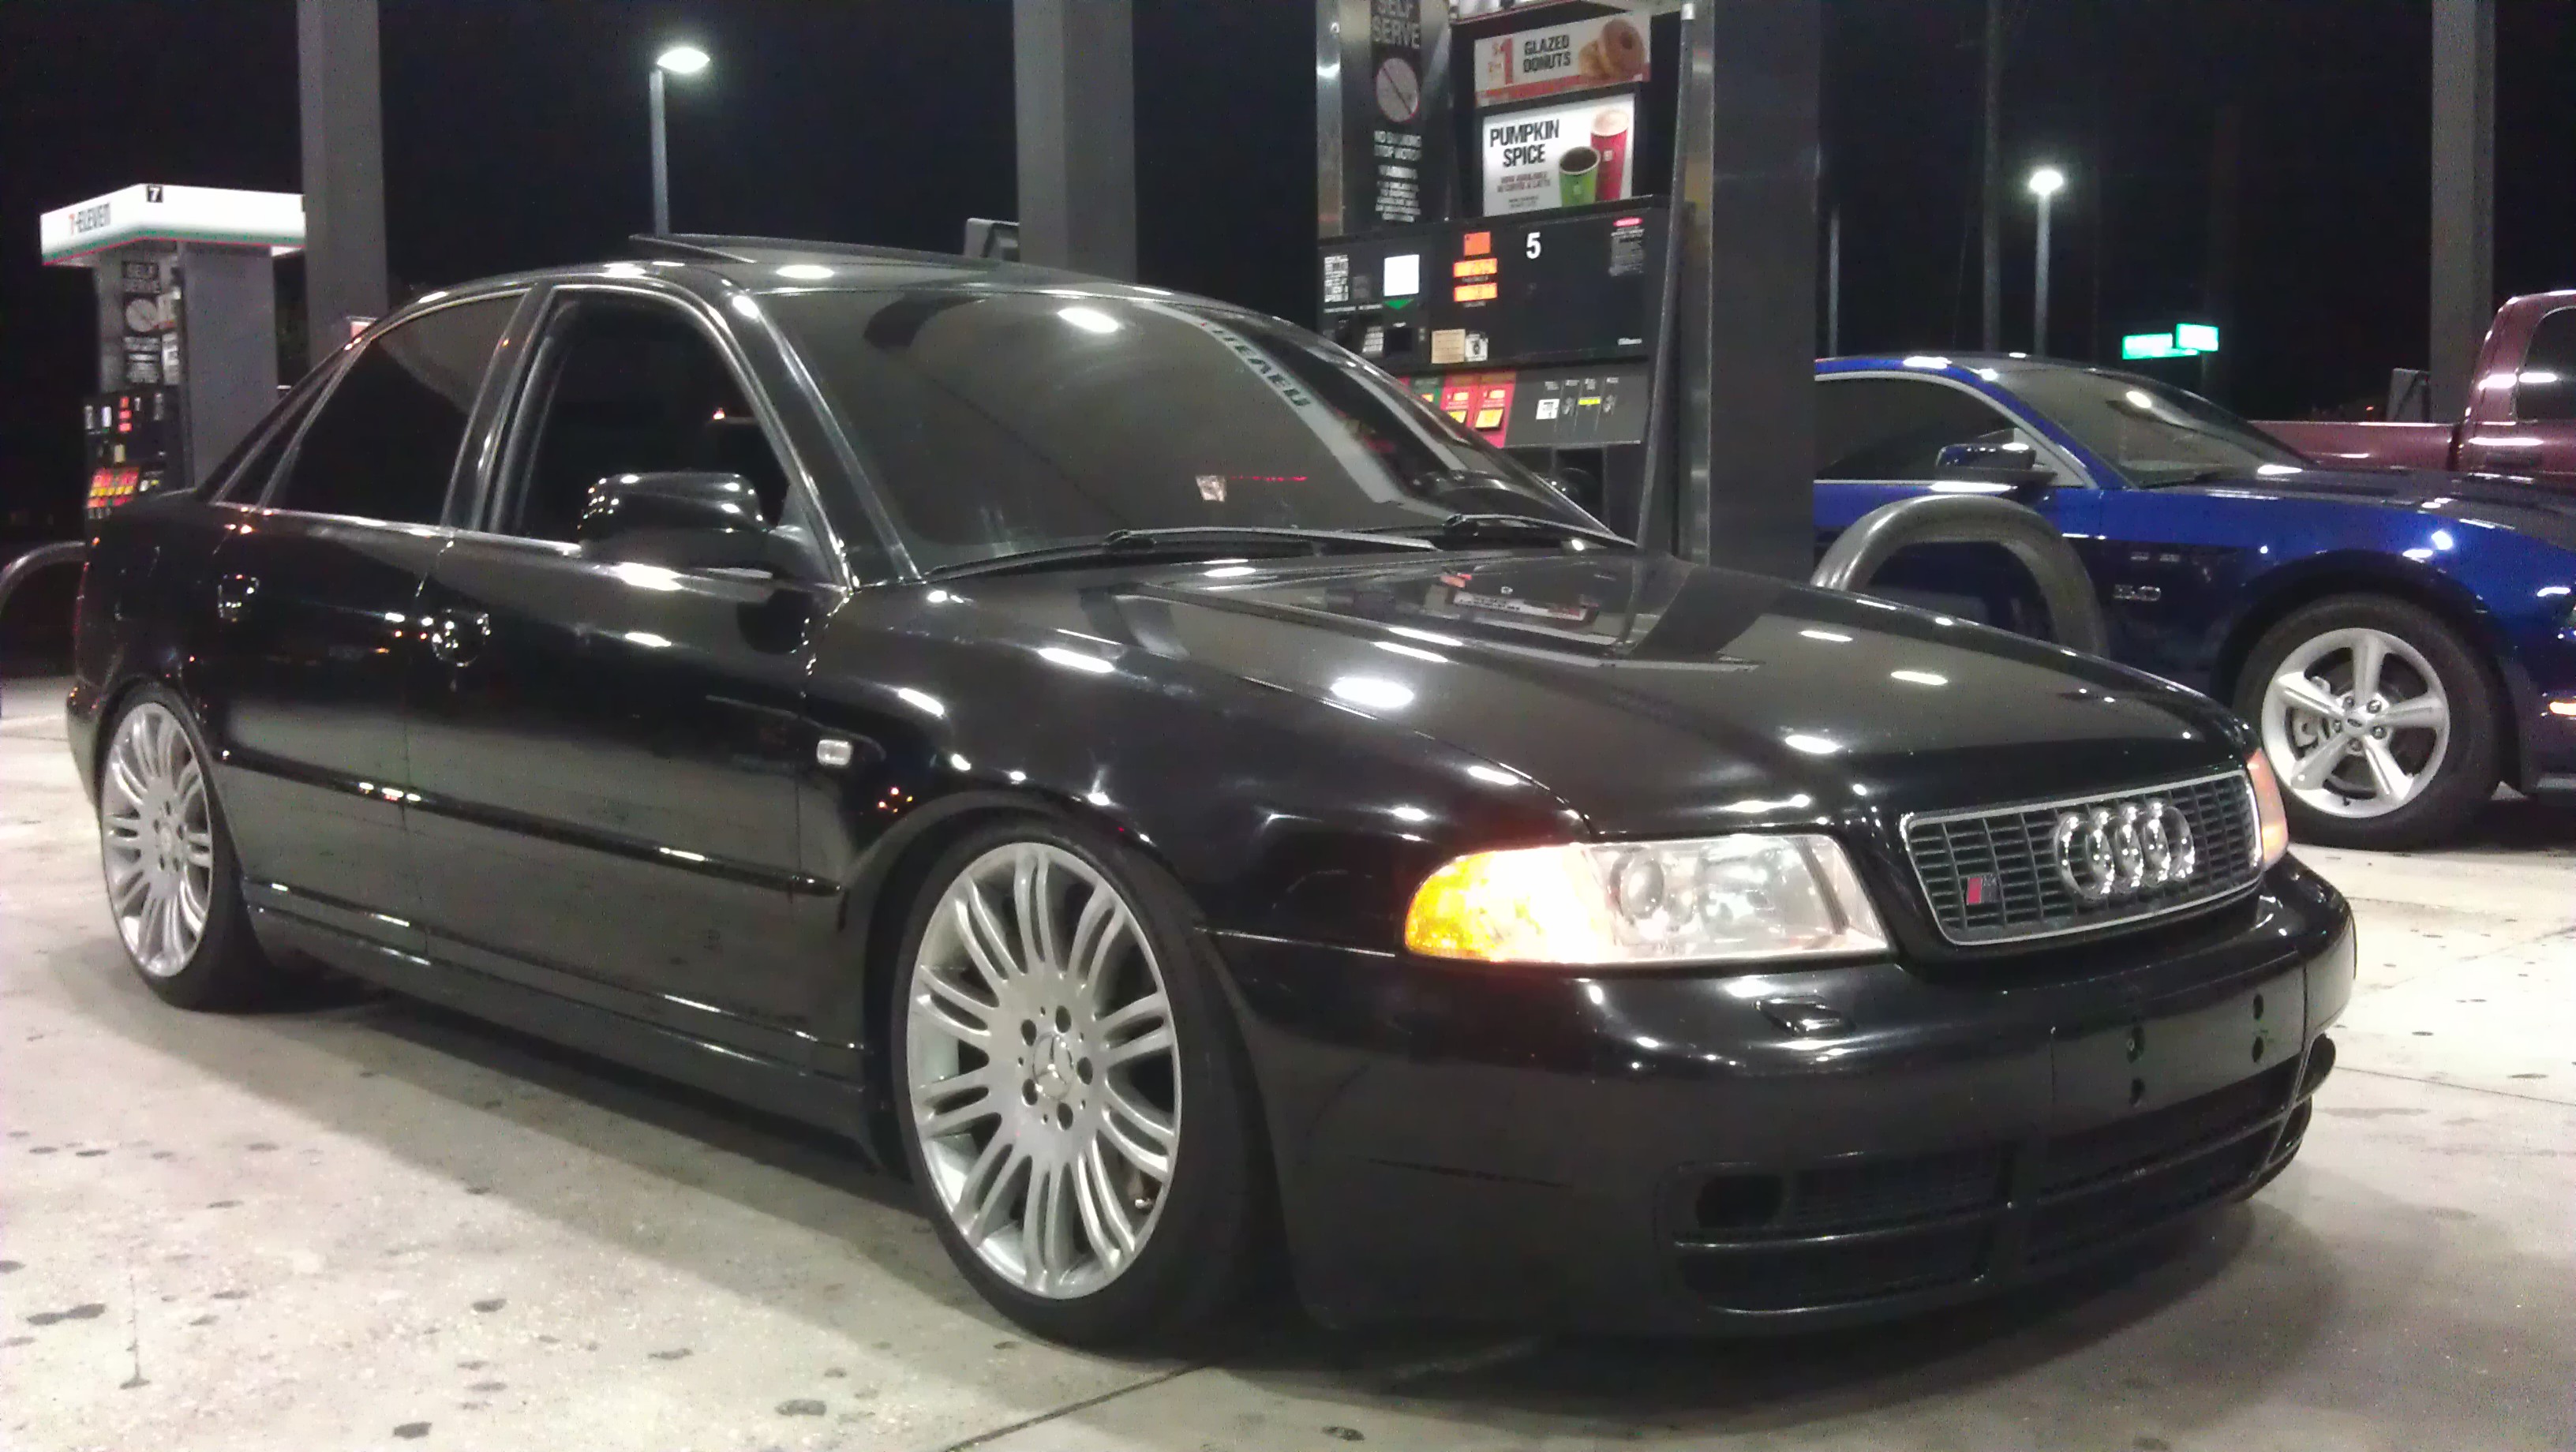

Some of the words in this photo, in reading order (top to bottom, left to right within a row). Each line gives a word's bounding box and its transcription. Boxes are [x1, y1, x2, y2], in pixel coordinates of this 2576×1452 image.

[1372, 16, 1421, 49] SERVE
[1525, 35, 1570, 55] GLAZED
[1523, 51, 1571, 73] DONUTS
[1490, 119, 1559, 148] PUMPKIN
[1503, 144, 1545, 167] SPICE
[149, 187, 160, 203] 7
[1526, 231, 1541, 259] 5
